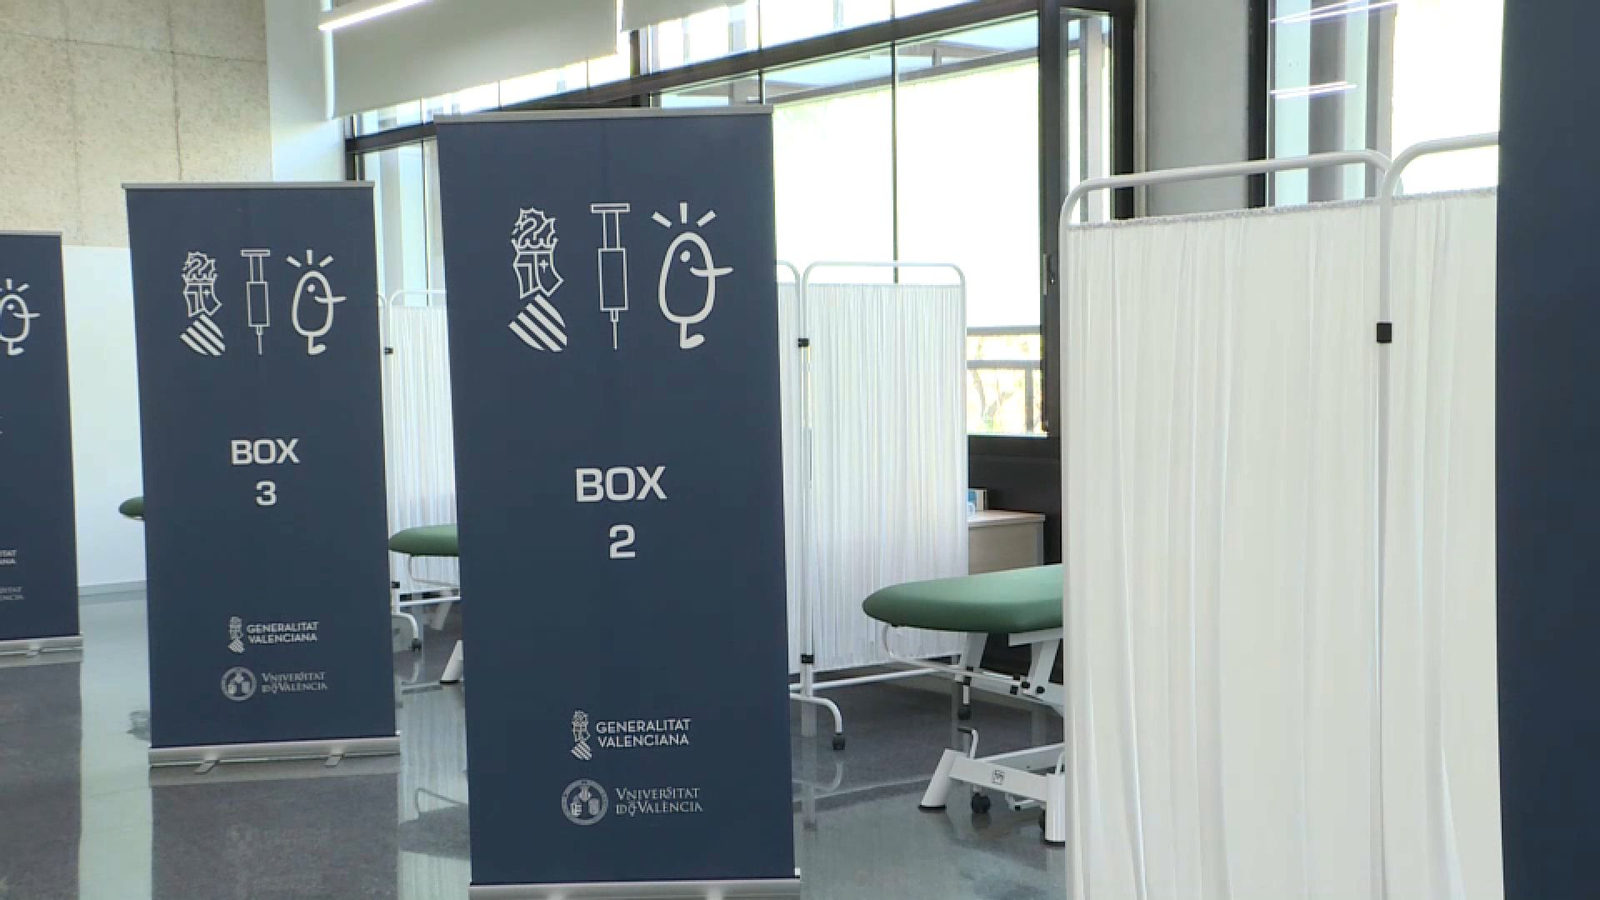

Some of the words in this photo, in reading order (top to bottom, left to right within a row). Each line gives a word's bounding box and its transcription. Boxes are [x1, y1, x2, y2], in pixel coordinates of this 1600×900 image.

[231, 438, 300, 465] BOX
[255, 480, 278, 506] 3
[575, 465, 668, 503] BOX
[609, 524, 636, 560] 2
[246, 621, 320, 634] GENERALITAT
[247, 633, 318, 644] VALENCIANA
[596, 718, 692, 734] GENERALITAT
[597, 734, 690, 748] VALENCIANA
